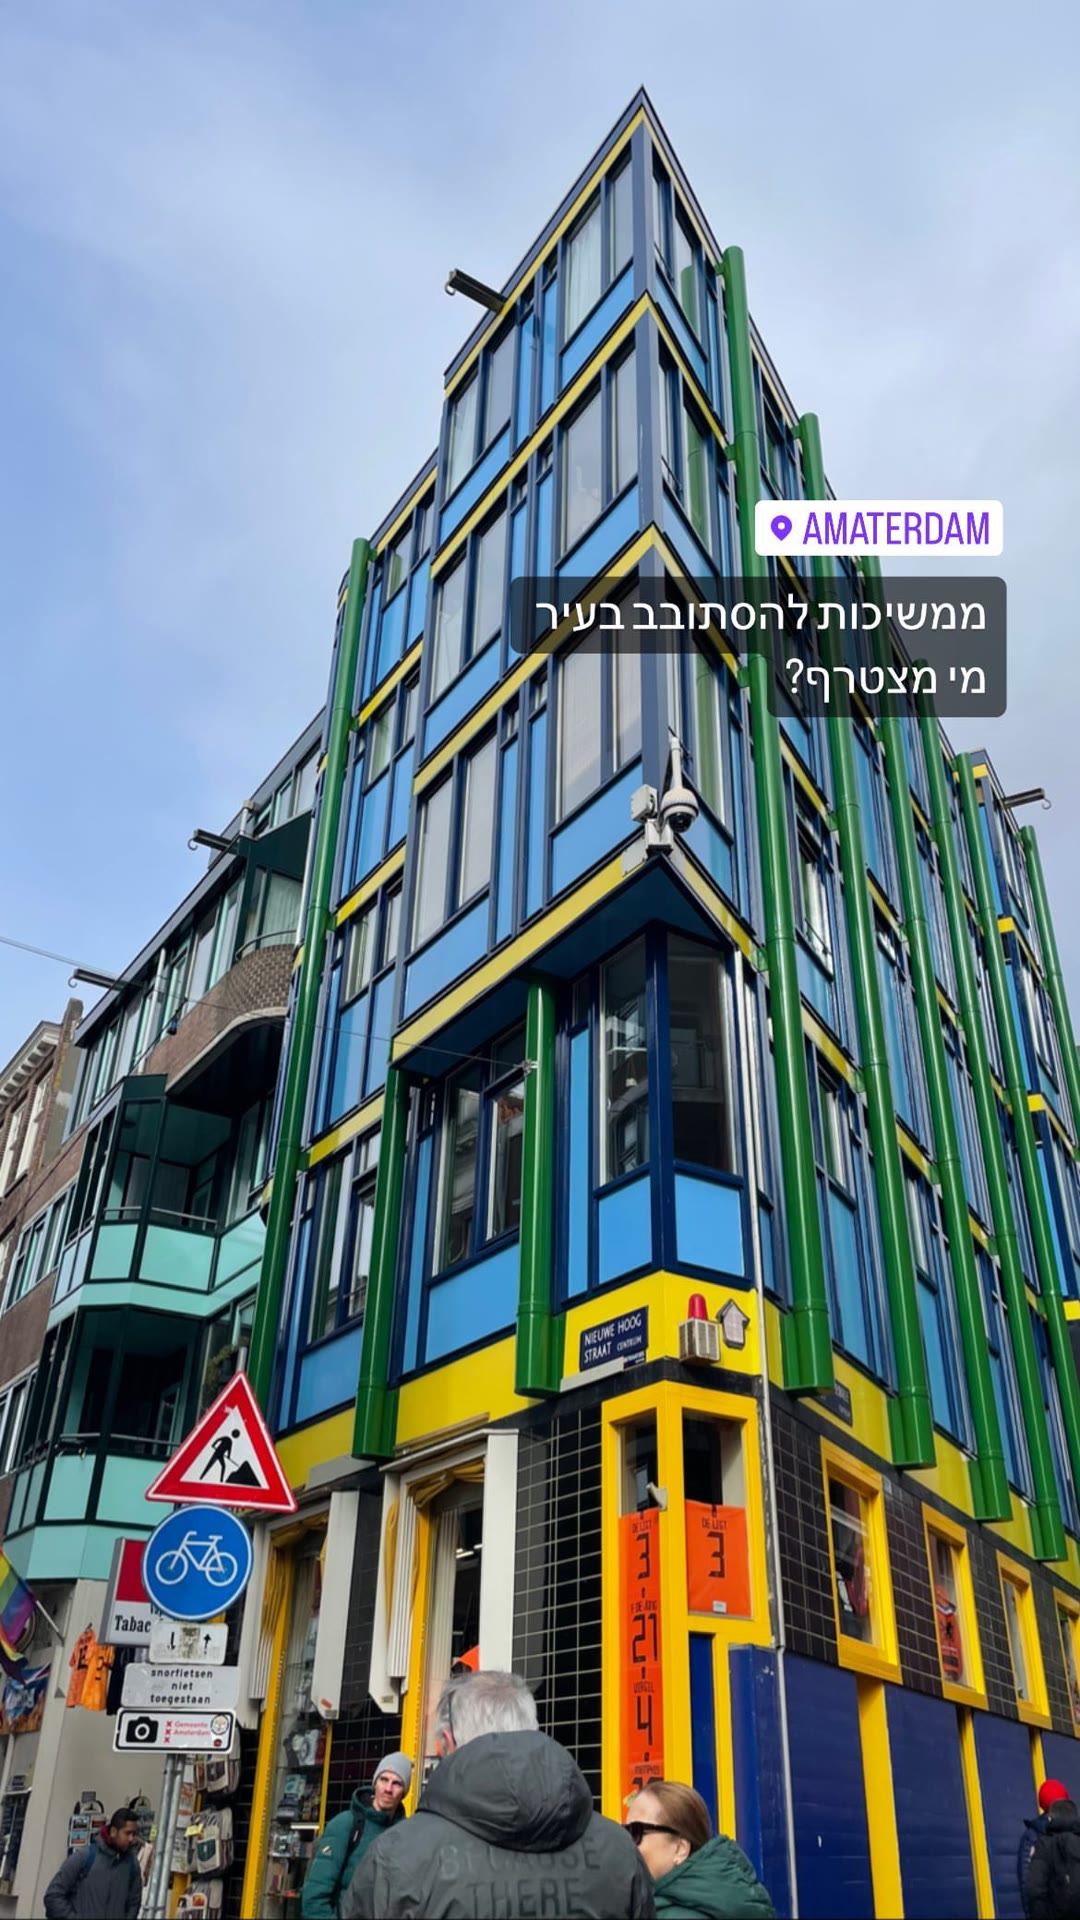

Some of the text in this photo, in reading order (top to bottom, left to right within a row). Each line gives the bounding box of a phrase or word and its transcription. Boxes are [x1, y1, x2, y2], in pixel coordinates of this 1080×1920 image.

[584, 1313, 642, 1346] NIEUWE HOOG
[584, 1341, 612, 1364] STRAAT
[617, 1336, 642, 1351] CENTRUM
[702, 1518, 711, 1530] DE
[636, 1532, 651, 1580] 3
[707, 1530, 725, 1578] 3
[114, 1614, 151, 1633] Tabac
[632, 1613, 658, 1664] 21
[151, 1668, 213, 1678] snorfietsen
[171, 1681, 193, 1691] niet
[150, 1694, 211, 1705] toegestaan
[174, 1721, 208, 1729] Gemeente
[637, 1695, 652, 1746] 4
[172, 1729, 211, 1737] Amsterdam
[466, 1877, 583, 1918] THERE
